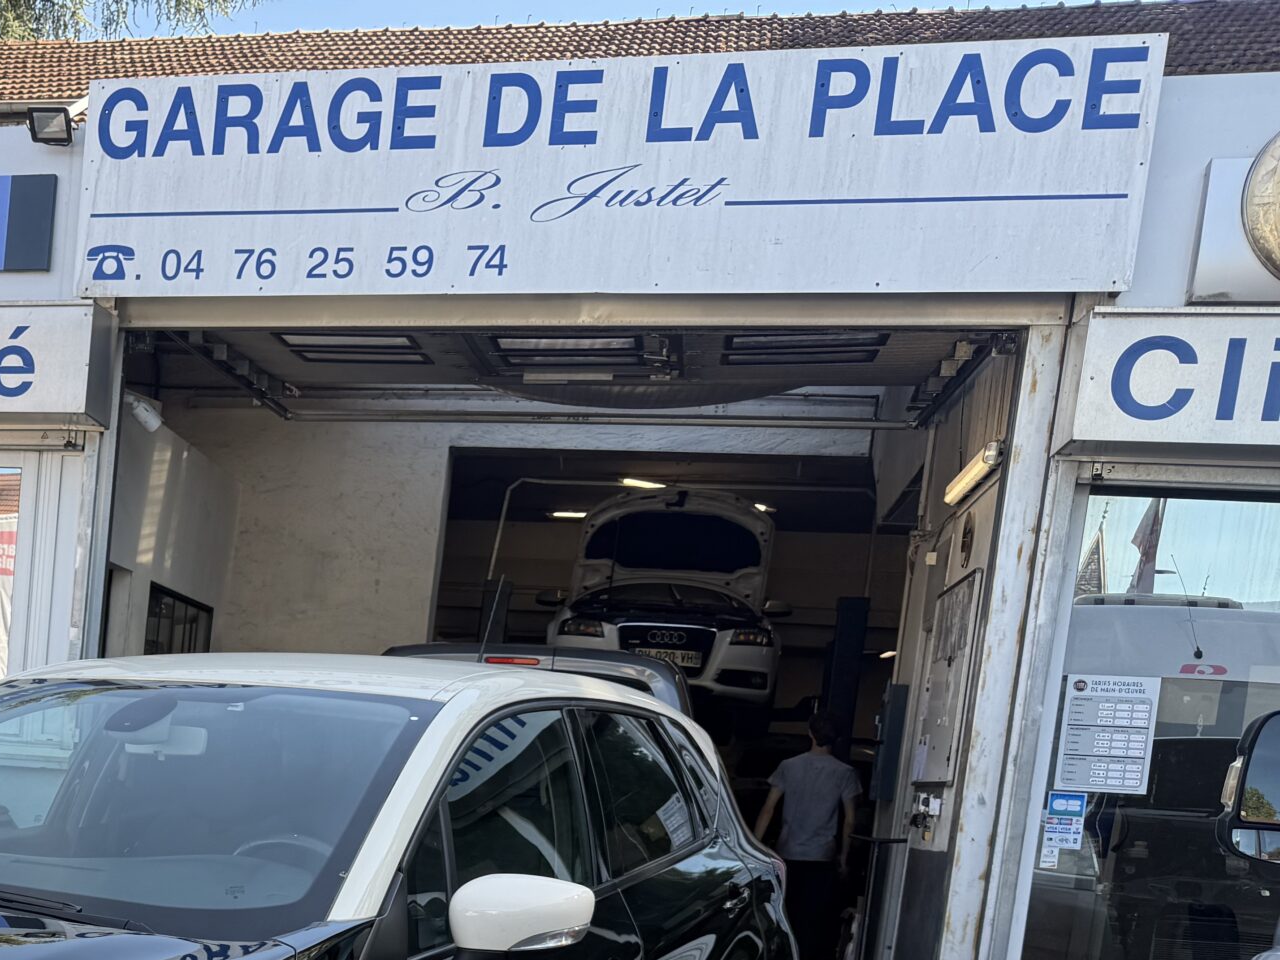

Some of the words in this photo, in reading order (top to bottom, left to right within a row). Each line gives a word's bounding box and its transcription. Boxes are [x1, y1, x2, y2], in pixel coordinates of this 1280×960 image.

[97, 75, 442, 160] GARAGE
[483, 69, 604, 148] DE
[645, 62, 759, 143] LA
[808, 46, 1150, 138] PLACE
[405, 168, 502, 213] B.
[529, 163, 731, 223] Justet
[160, 248, 204, 281] 04
[233, 247, 277, 280] 76
[306, 246, 354, 279] 25
[385, 244, 434, 278] 59
[466, 244, 508, 277] 74
